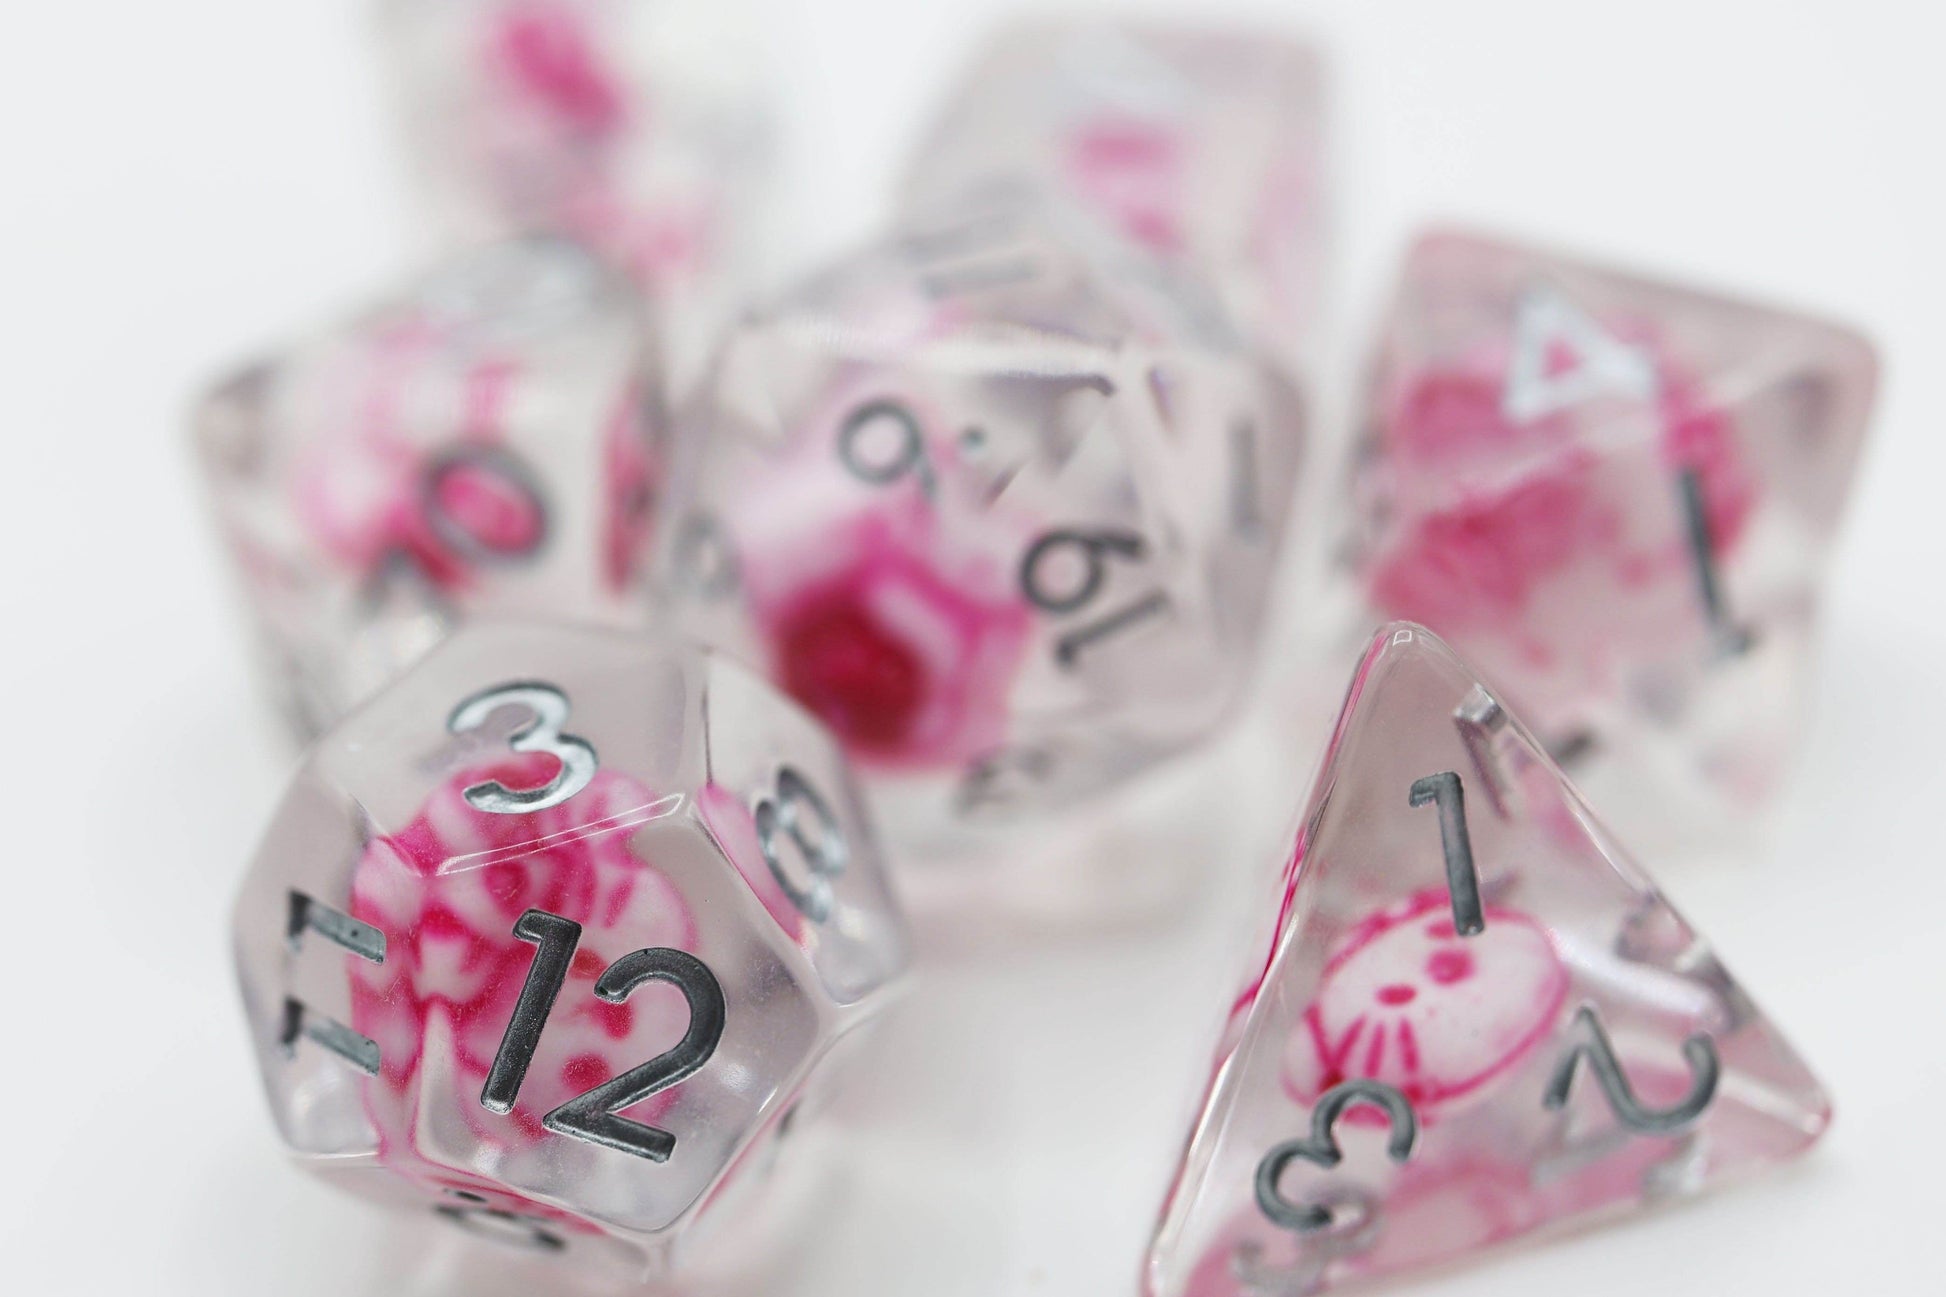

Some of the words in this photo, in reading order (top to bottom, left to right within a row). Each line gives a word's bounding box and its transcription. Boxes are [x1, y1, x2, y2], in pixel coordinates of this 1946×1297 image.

[446, 680, 597, 815] 3
[1409, 771, 1485, 936] 1
[280, 888, 387, 1077] 11
[480, 908, 727, 1163] 12
[1543, 1006, 1721, 1131] 2
[1254, 1078, 1418, 1231] 3
